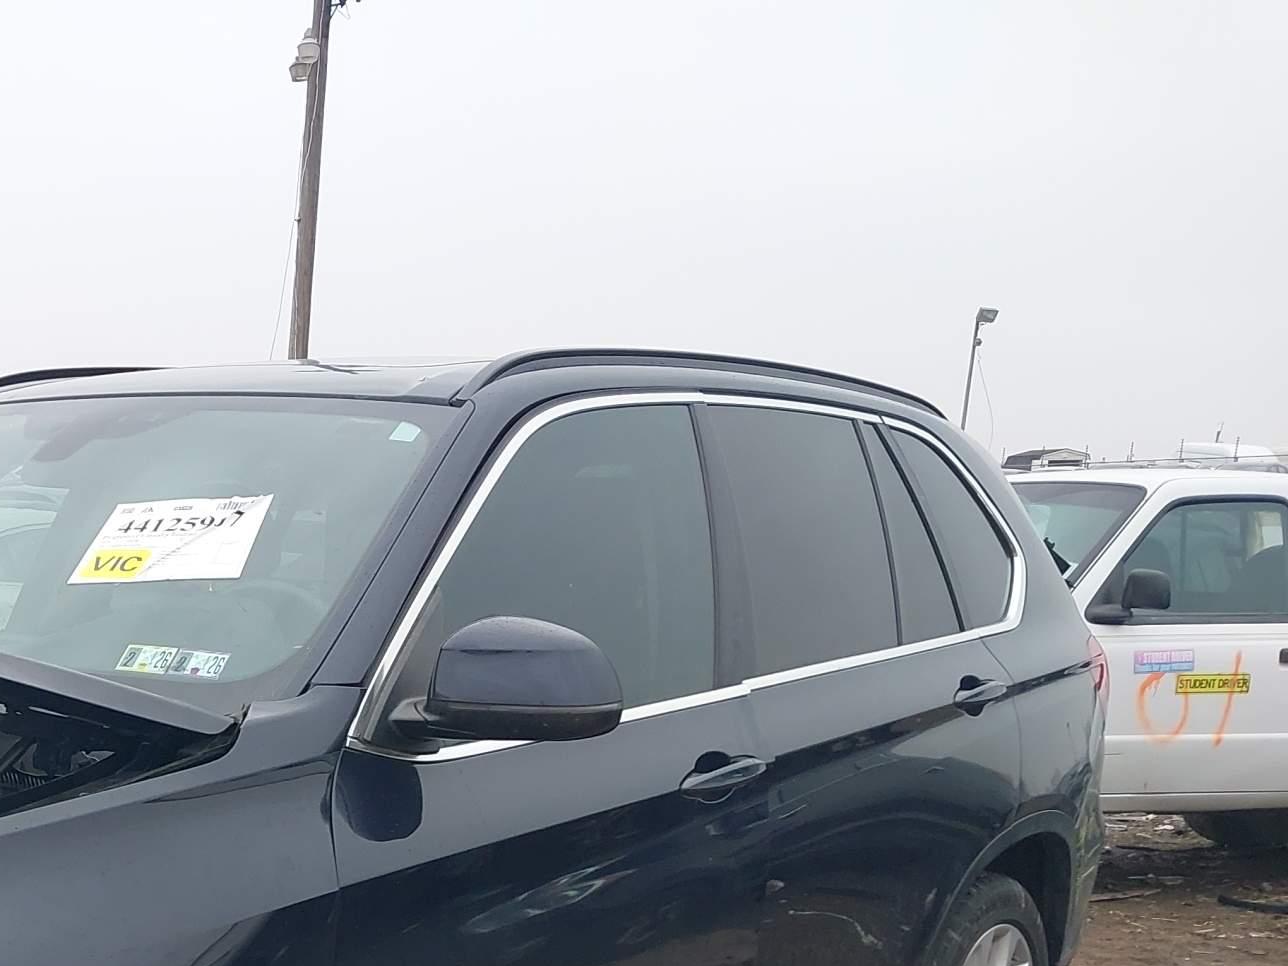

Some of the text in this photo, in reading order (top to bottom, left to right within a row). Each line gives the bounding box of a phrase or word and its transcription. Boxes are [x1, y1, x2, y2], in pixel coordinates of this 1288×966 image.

[94, 556, 143, 571] VIC
[122, 651, 173, 669] 2 26
[207, 656, 226, 675] 26
[1178, 678, 1216, 689] STUDENT
